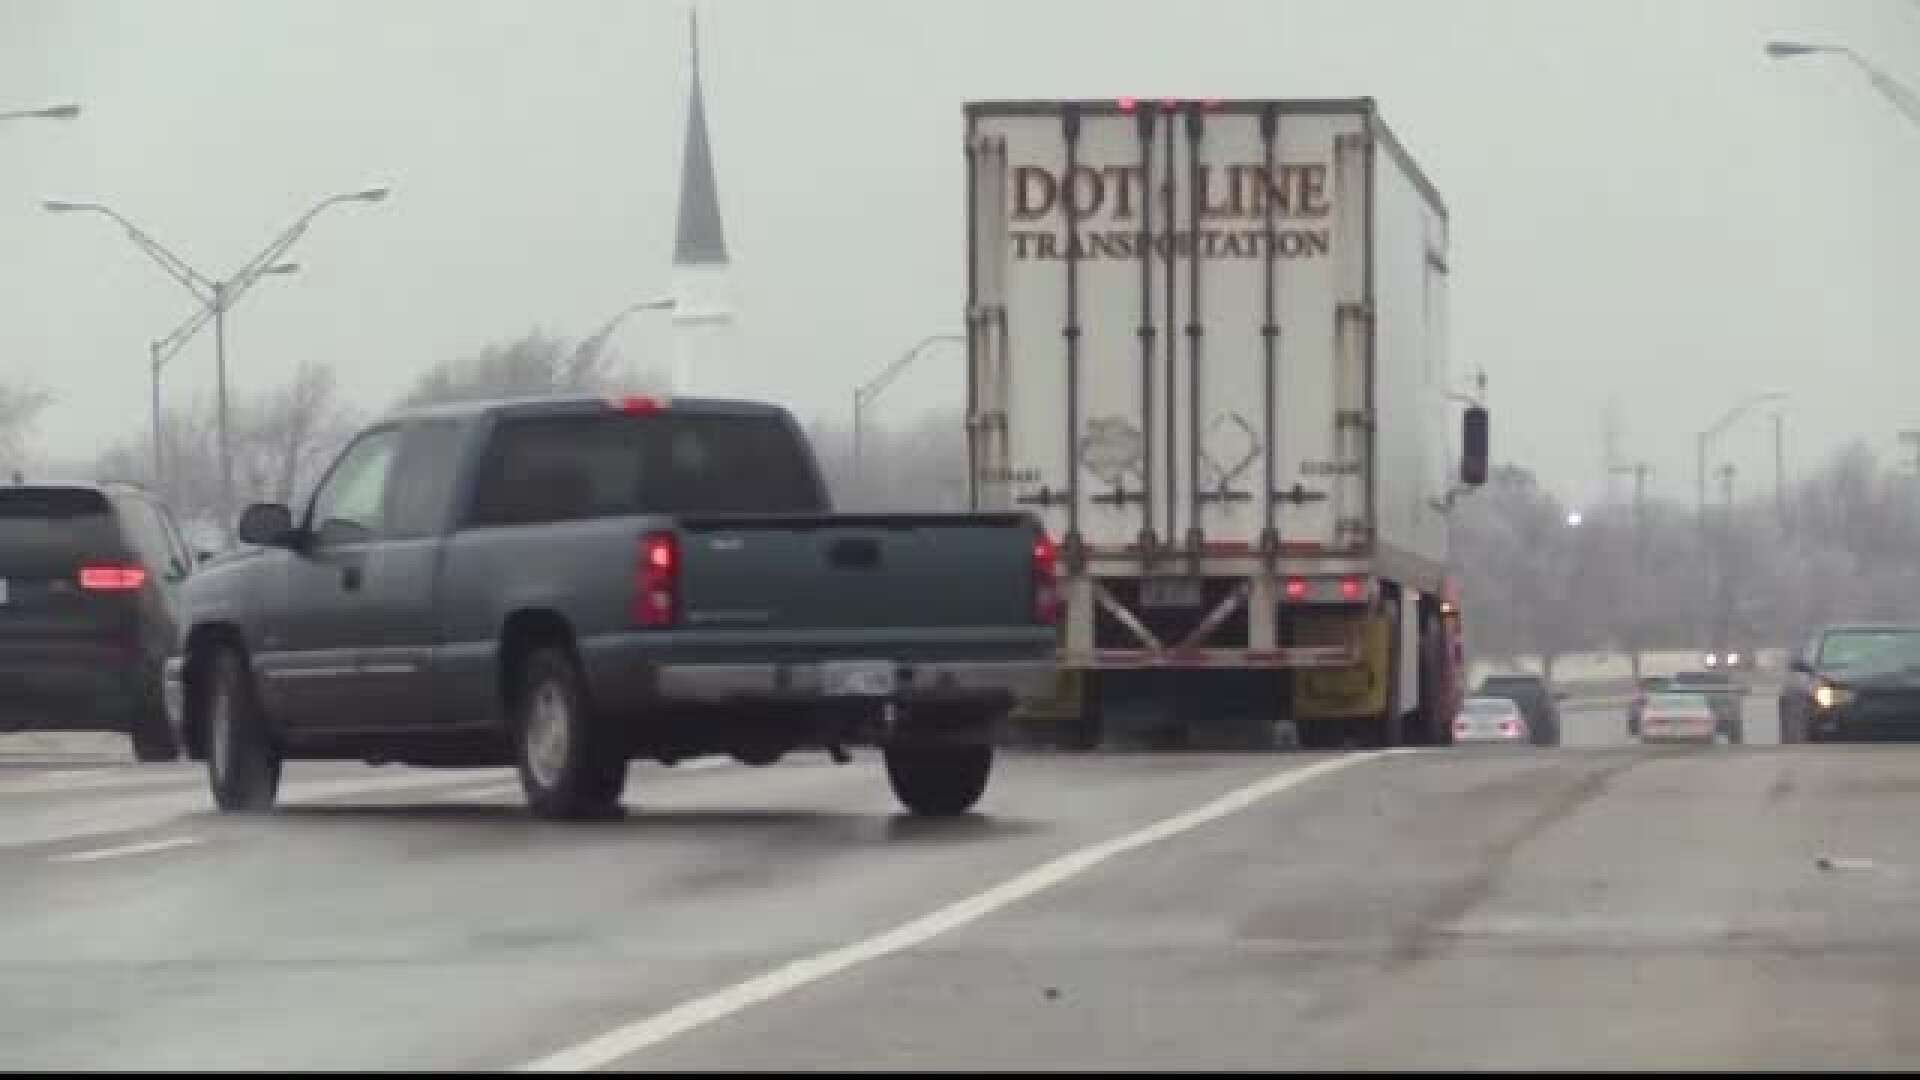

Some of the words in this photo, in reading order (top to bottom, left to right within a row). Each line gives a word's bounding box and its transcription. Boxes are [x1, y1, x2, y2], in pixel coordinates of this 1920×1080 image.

[1012, 165, 1146, 221] DOT
[1197, 163, 1331, 219] LINE
[1010, 232, 1331, 261] TRANSPOTATON
